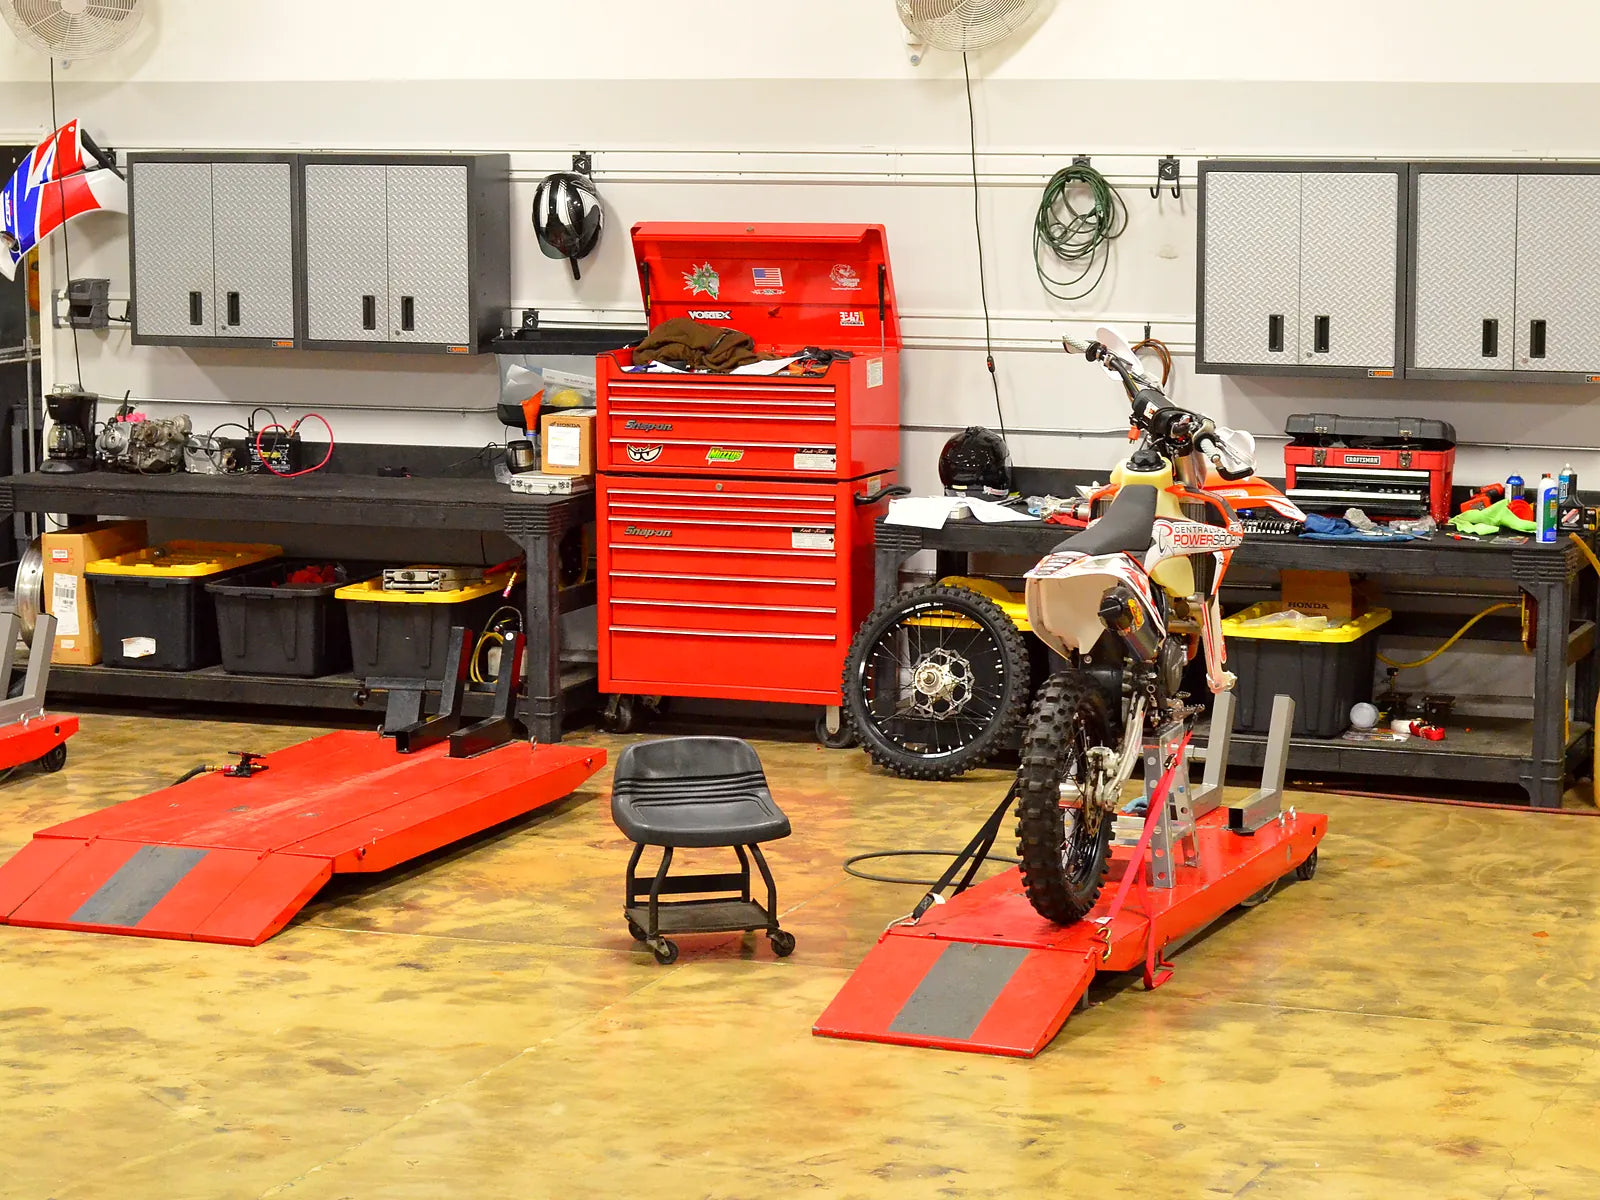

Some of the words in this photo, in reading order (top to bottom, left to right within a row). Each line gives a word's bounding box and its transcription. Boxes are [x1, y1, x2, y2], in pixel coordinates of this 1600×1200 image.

[687, 310, 732, 320] VORTEX
[1174, 526, 1216, 534] CENTRAL
[1288, 601, 1329, 610] HONDA
